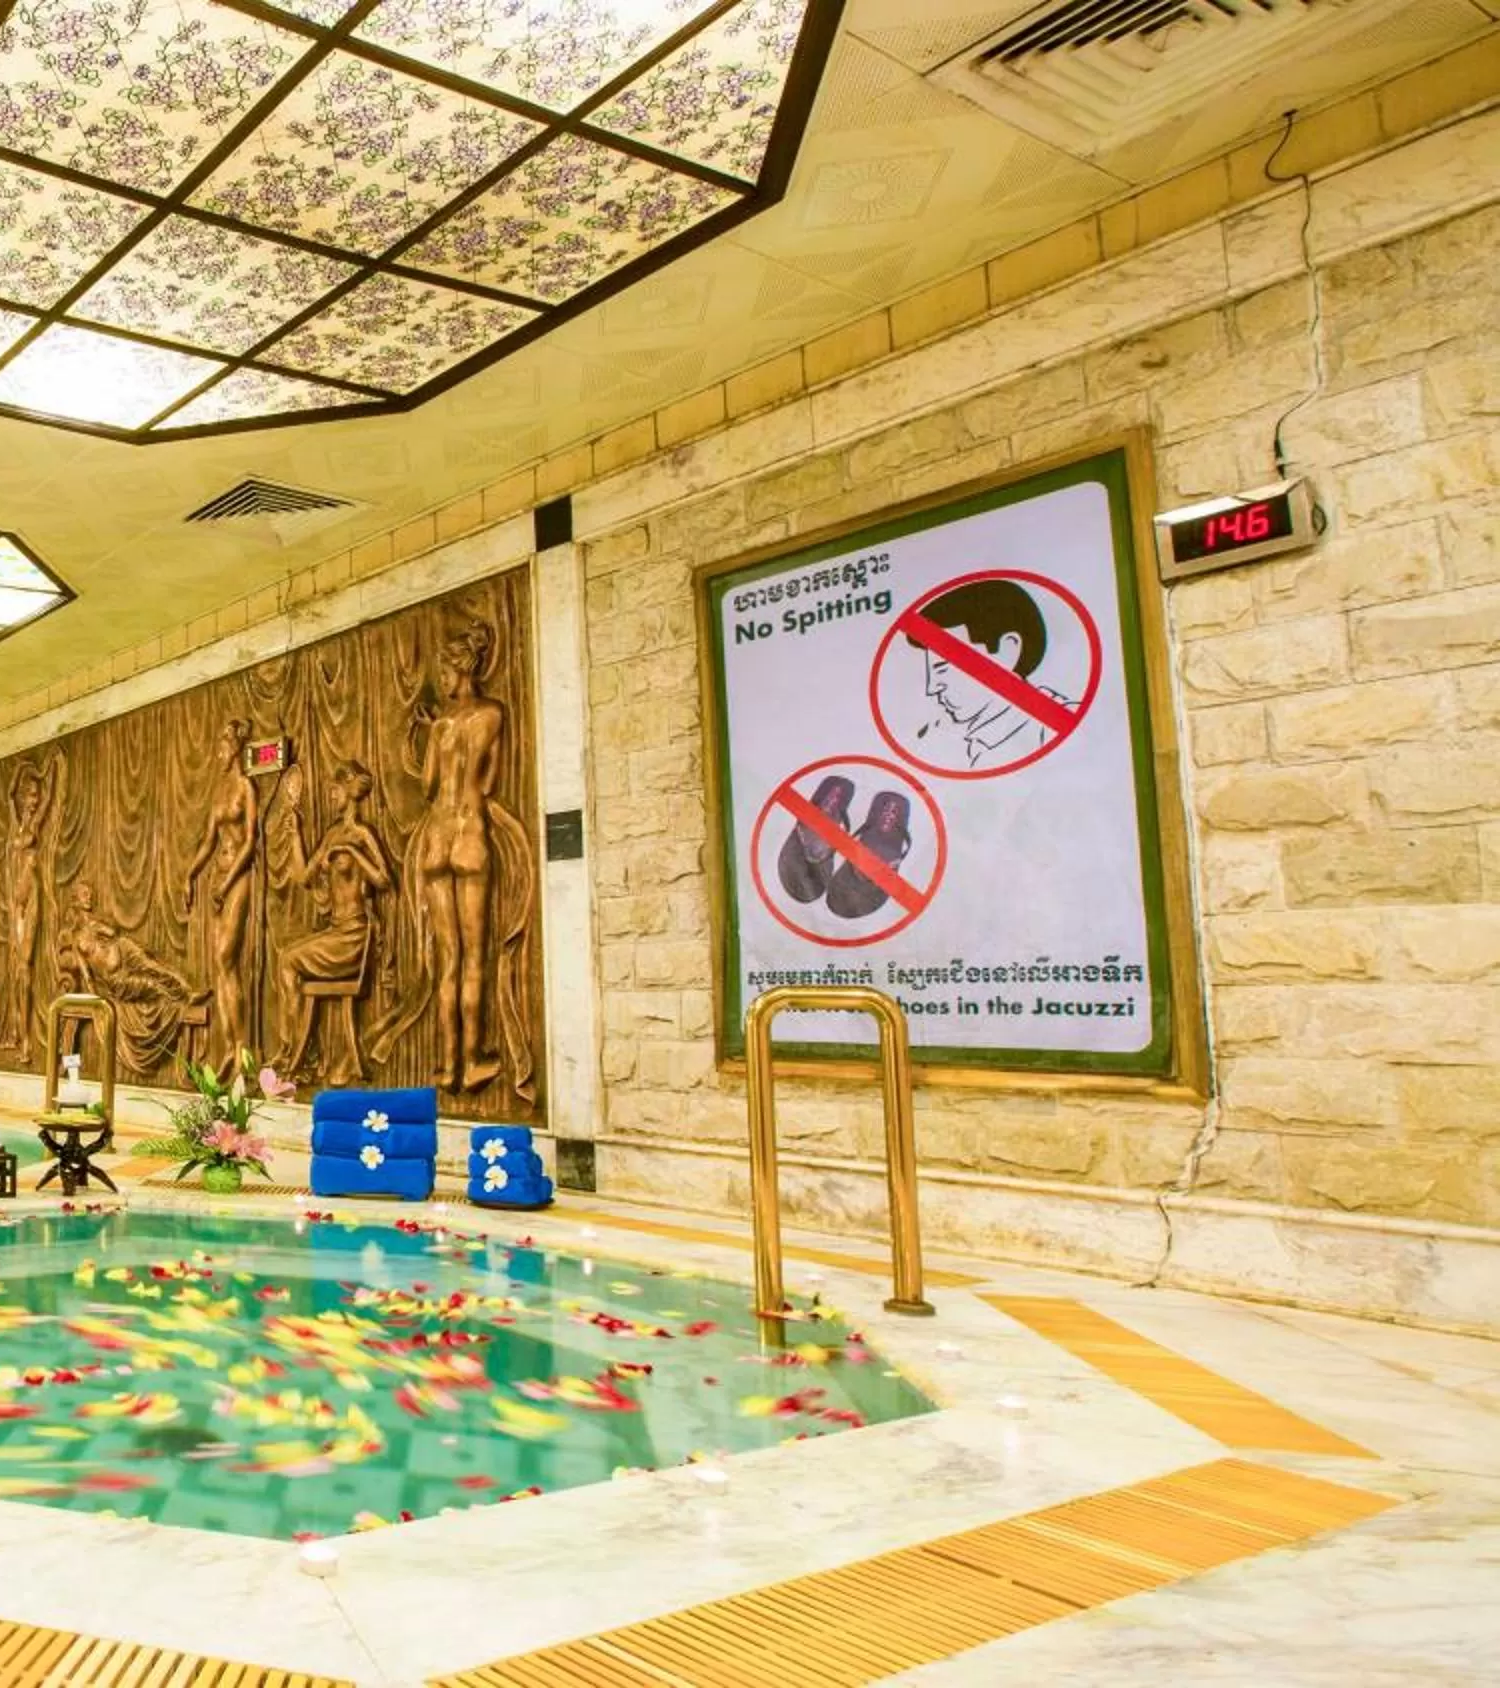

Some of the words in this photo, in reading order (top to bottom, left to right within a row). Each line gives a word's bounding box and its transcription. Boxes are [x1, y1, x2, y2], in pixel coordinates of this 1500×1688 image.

[736, 621, 773, 644] No
[783, 589, 892, 634] Spitting
[896, 995, 950, 1015] hoes
[957, 995, 979, 1015] in
[987, 996, 1023, 1015] the
[1032, 997, 1135, 1017] Jacuzzi
